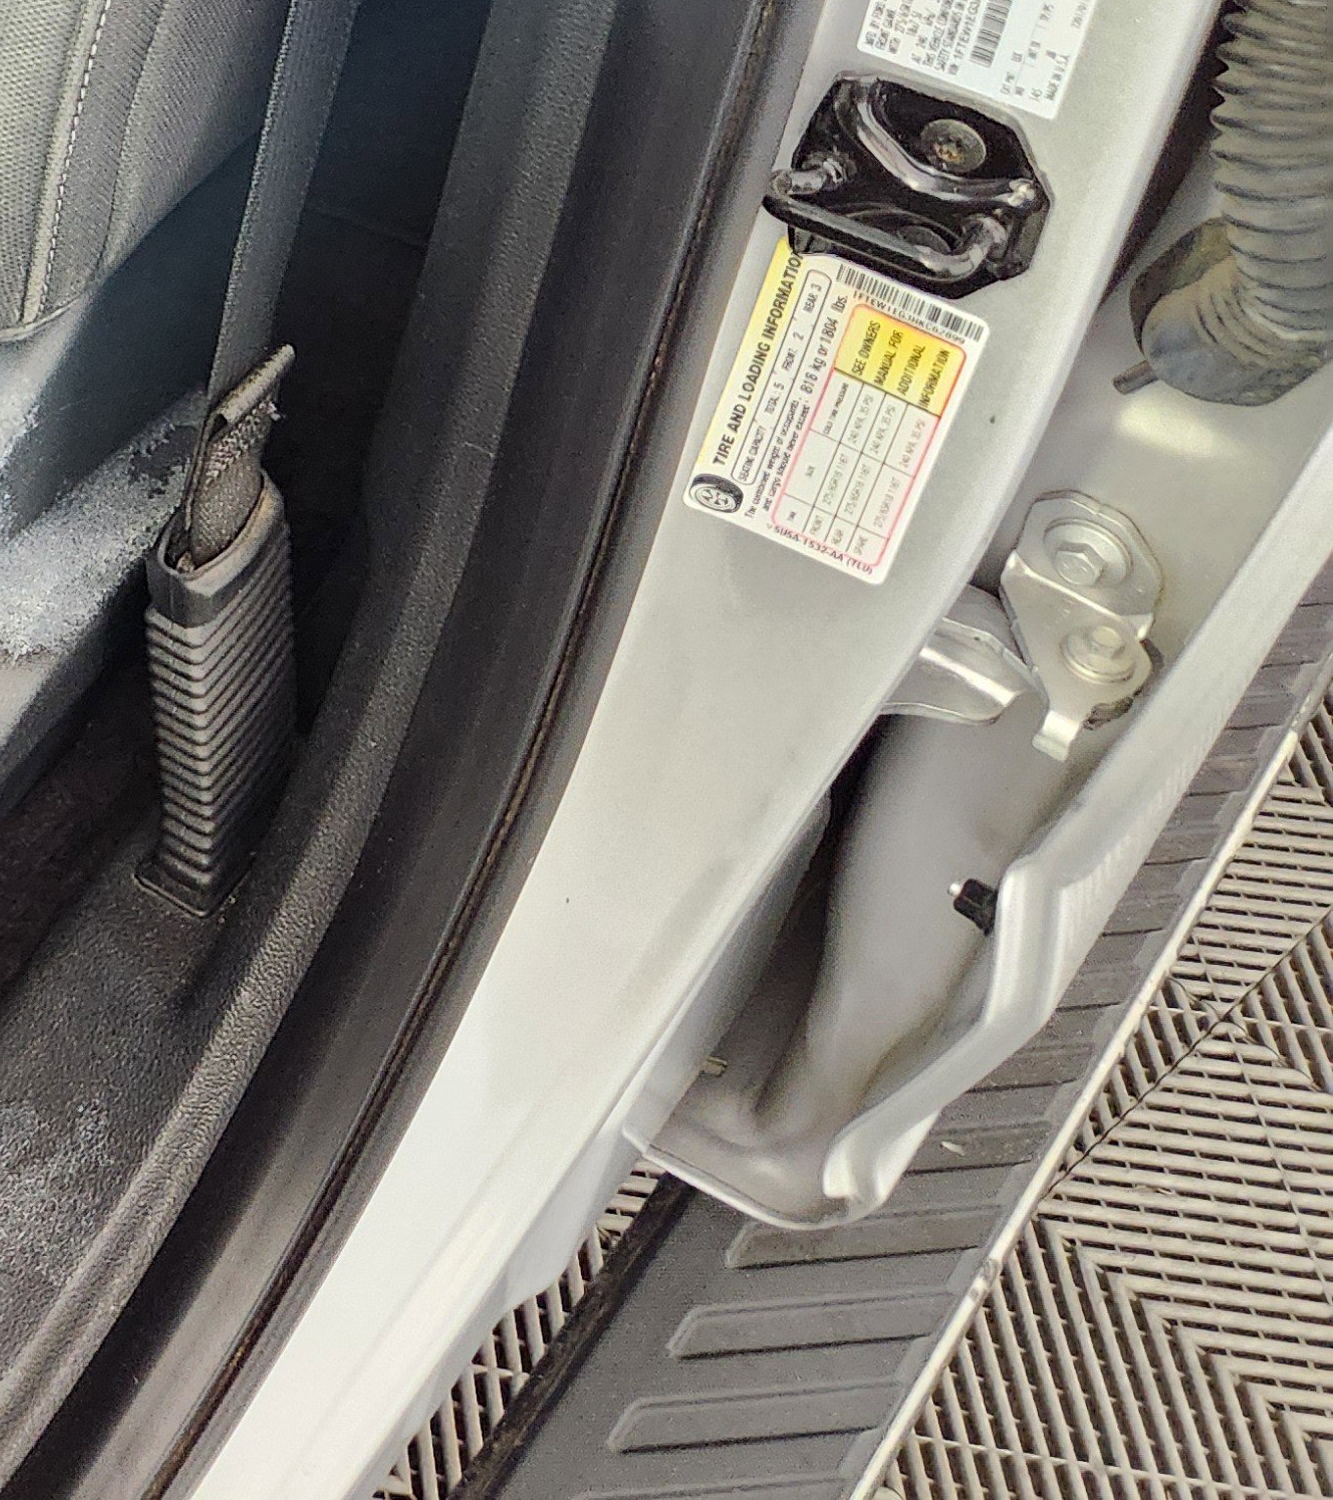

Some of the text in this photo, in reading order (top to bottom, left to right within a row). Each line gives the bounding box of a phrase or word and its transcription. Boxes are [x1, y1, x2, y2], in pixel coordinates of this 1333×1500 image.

[815, 343, 830, 357] or
[817, 315, 840, 345] 1804
[849, 318, 882, 377] SEE OWNERS
[872, 328, 904, 387] MANUAL FOR
[807, 354, 827, 373] kg
[894, 341, 926, 396] ADDITIONAL
[916, 346, 951, 409] INFORMATION
[711, 432, 736, 468] TIRE
[725, 401, 748, 434] AND
[737, 339, 771, 403] LOADING
